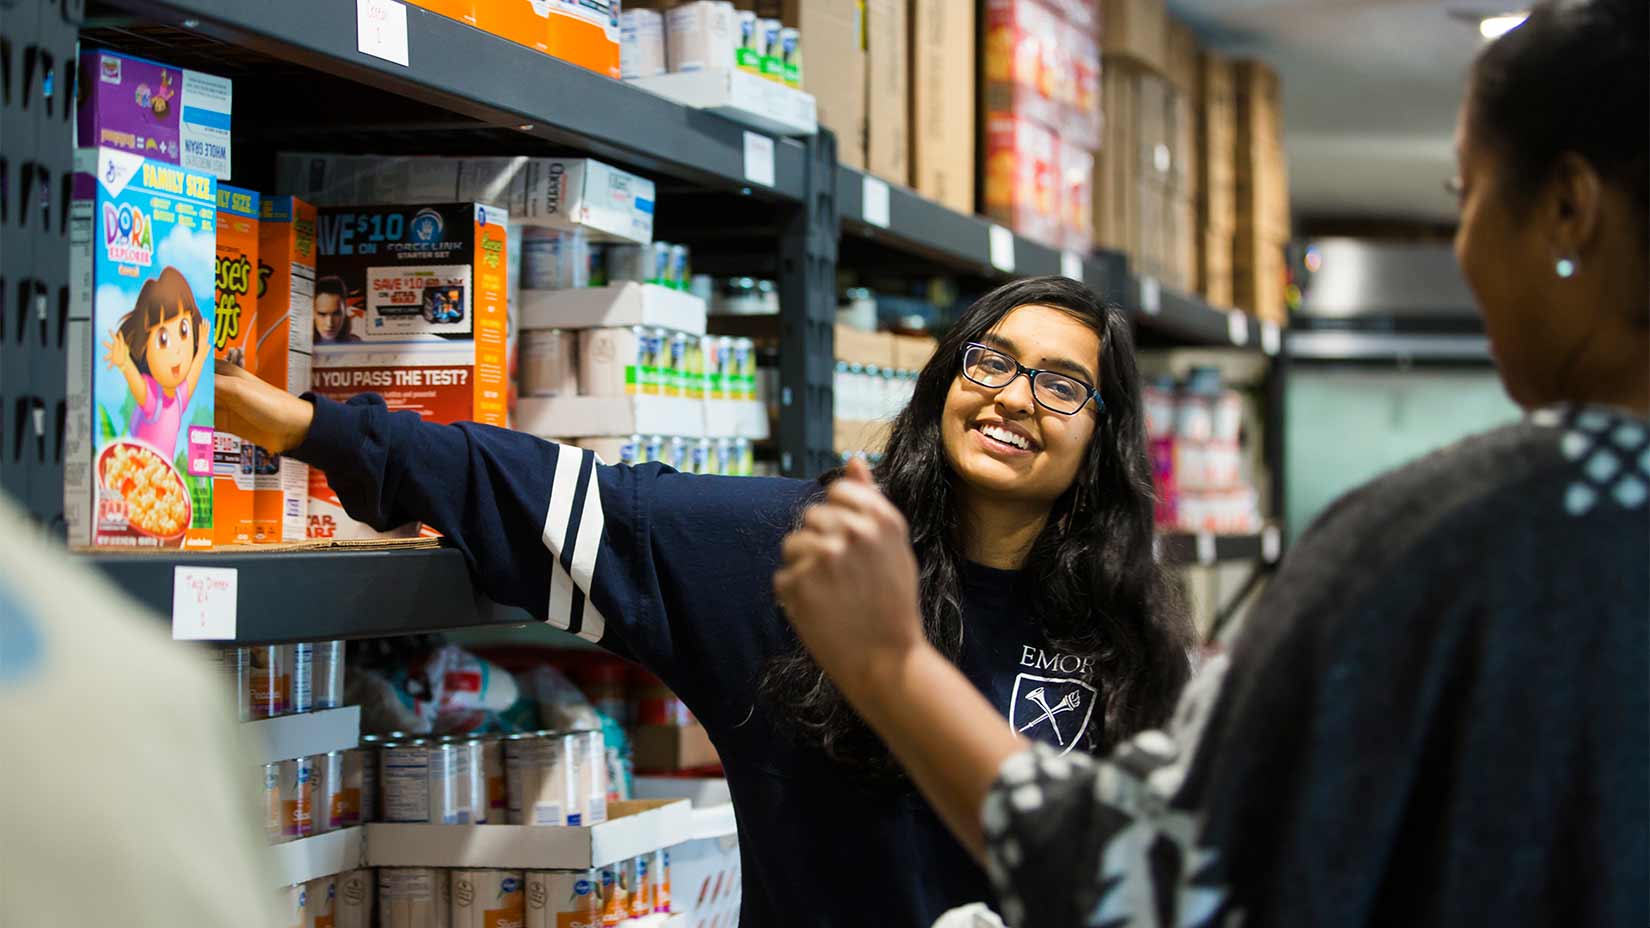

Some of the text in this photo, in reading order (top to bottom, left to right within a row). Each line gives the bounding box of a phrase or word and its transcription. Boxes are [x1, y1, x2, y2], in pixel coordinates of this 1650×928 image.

[185, 139, 227, 160] WHOLE GRAIN
[143, 164, 184, 194] FAMILY
[186, 174, 210, 200] SIZE
[216, 189, 231, 209] ILY
[232, 192, 252, 213] SIZE
[104, 203, 152, 251] DORA
[318, 213, 354, 256] AVE
[357, 213, 404, 242] $10
[109, 246, 151, 265] EXPLORER
[358, 244, 377, 254] ON
[387, 241, 463, 252] FORCE LINK
[397, 252, 432, 260] STARTER
[215, 256, 250, 293] ese's
[373, 278, 423, 292] SAVE $10
[322, 372, 350, 387] YOU
[353, 371, 392, 387] PASS
[394, 371, 423, 386] THE
[424, 369, 468, 386] TEST?
[307, 514, 336, 527] AR
[306, 527, 336, 539] ARS
[1019, 644, 1095, 674] EMOR
